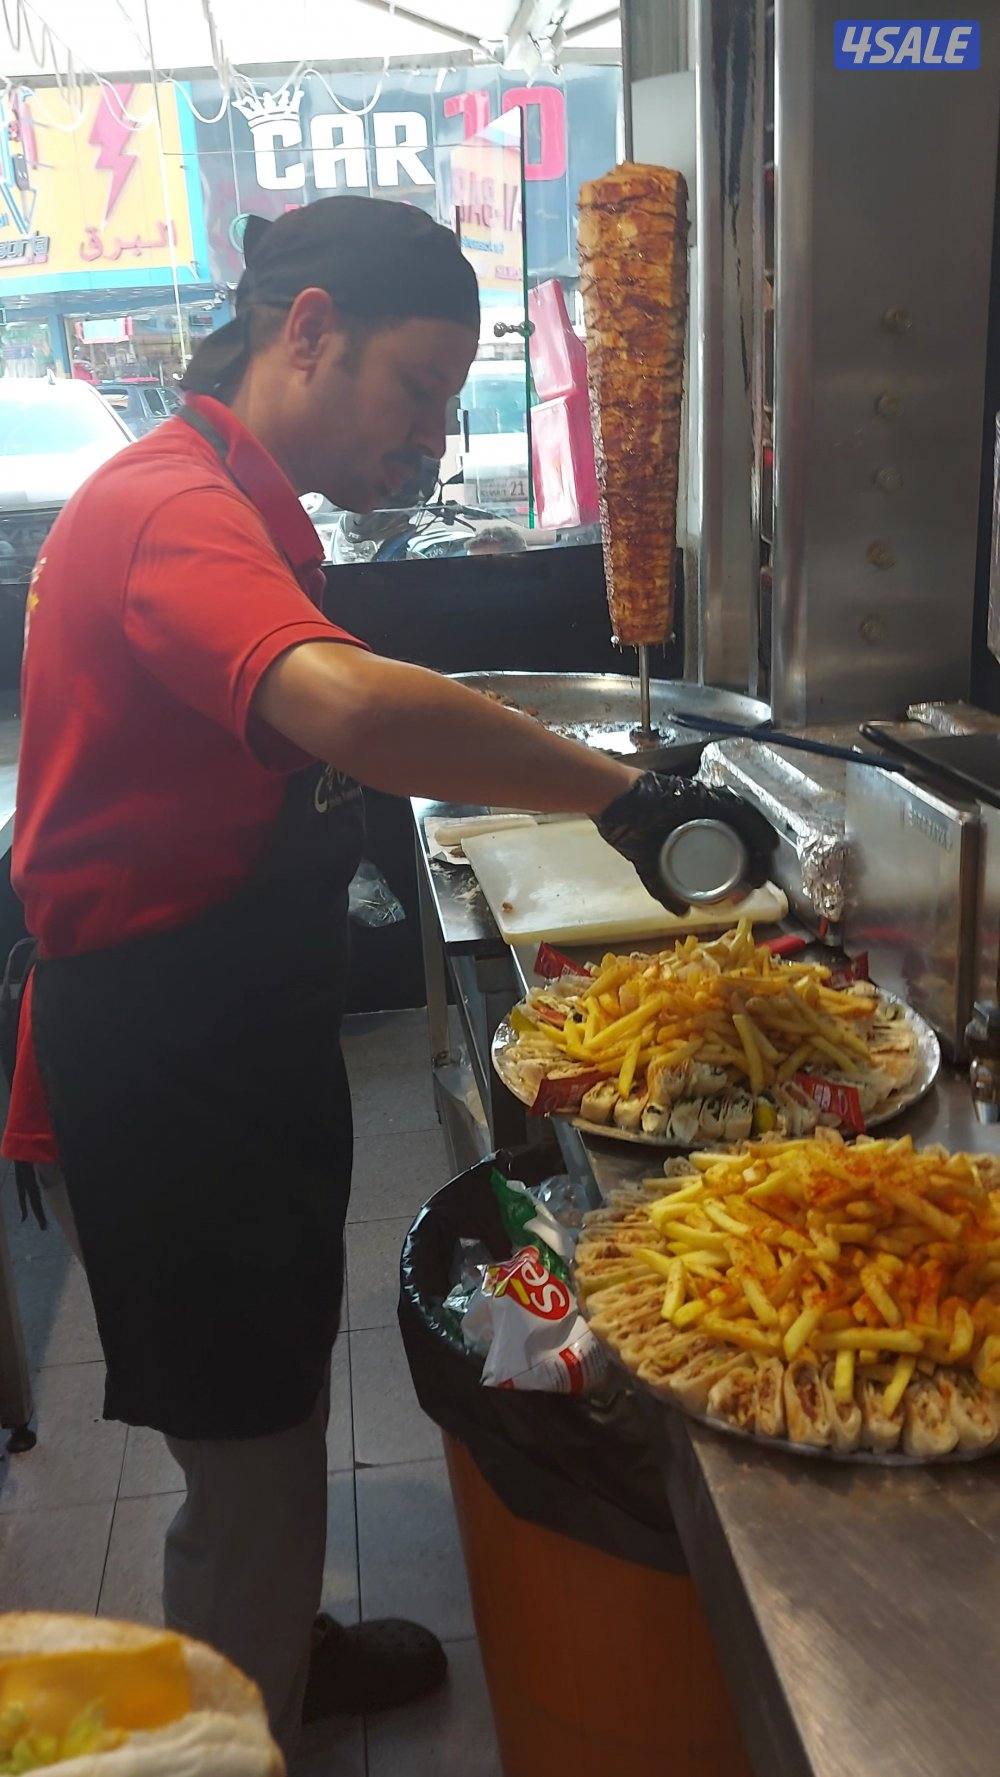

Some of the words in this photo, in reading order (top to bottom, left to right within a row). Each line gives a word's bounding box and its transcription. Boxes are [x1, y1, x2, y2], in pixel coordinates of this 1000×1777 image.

[251, 111, 435, 190] CAR
[79, 219, 178, 262] البرق
[510, 480, 525, 496] 21
